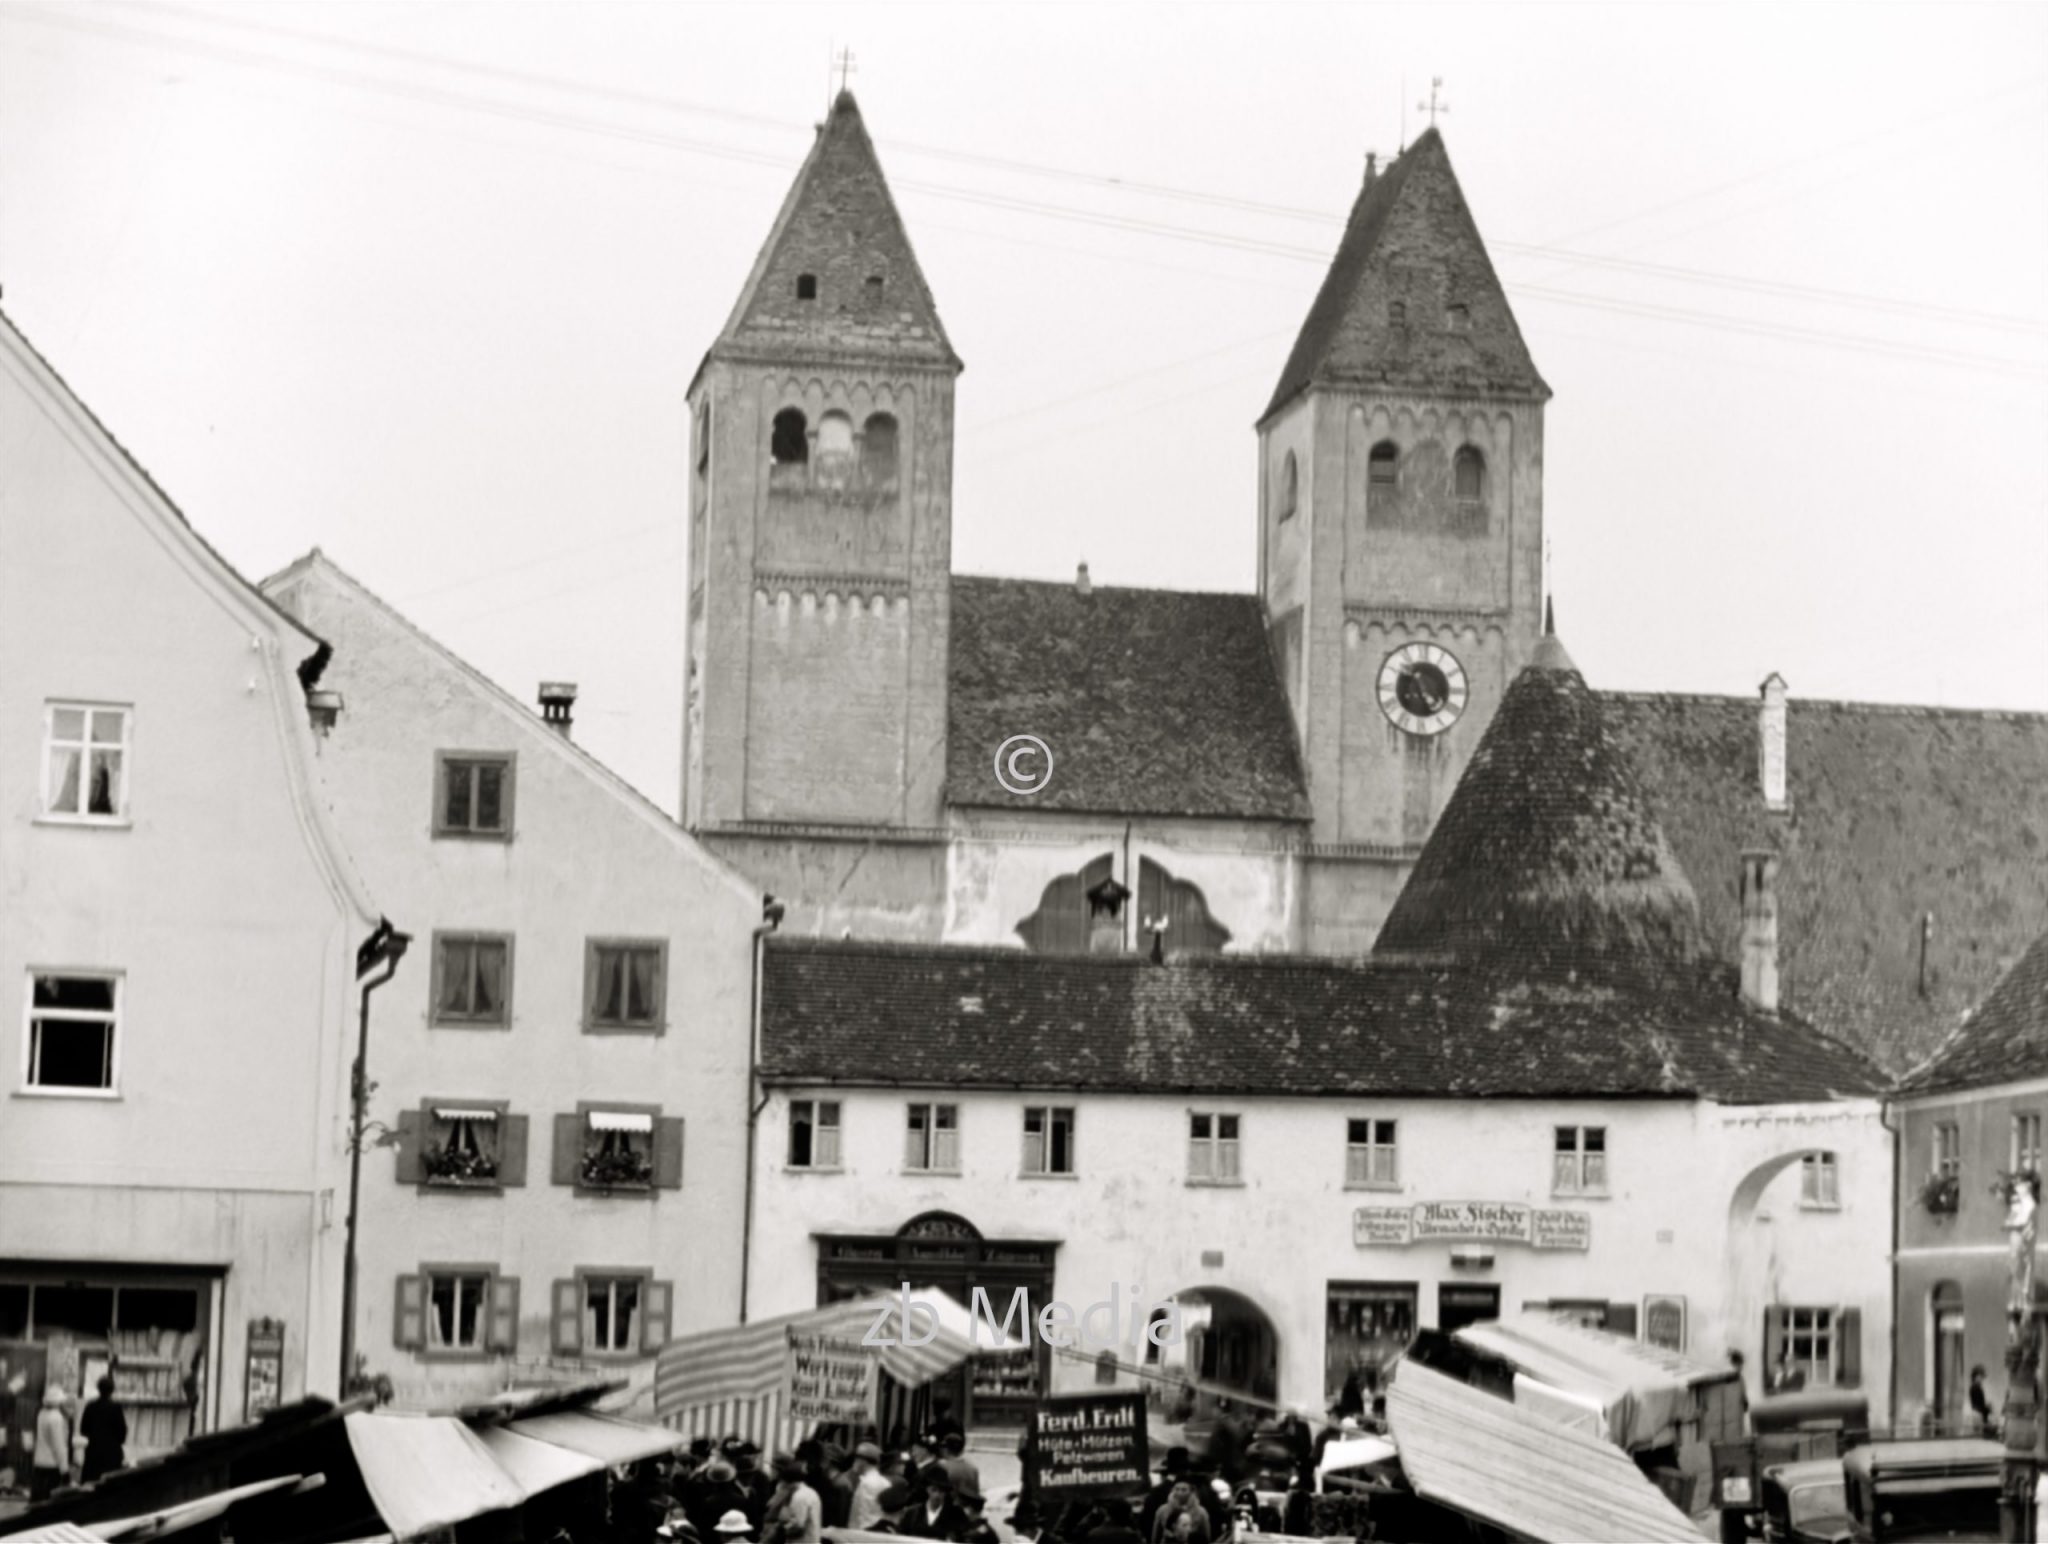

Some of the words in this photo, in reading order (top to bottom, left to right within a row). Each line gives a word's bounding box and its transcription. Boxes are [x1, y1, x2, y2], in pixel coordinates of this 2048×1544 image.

[1424, 1204, 1460, 1221] Max
[1466, 1204, 1525, 1223] Fischer
[1037, 1410, 1090, 1433] Ferd.
